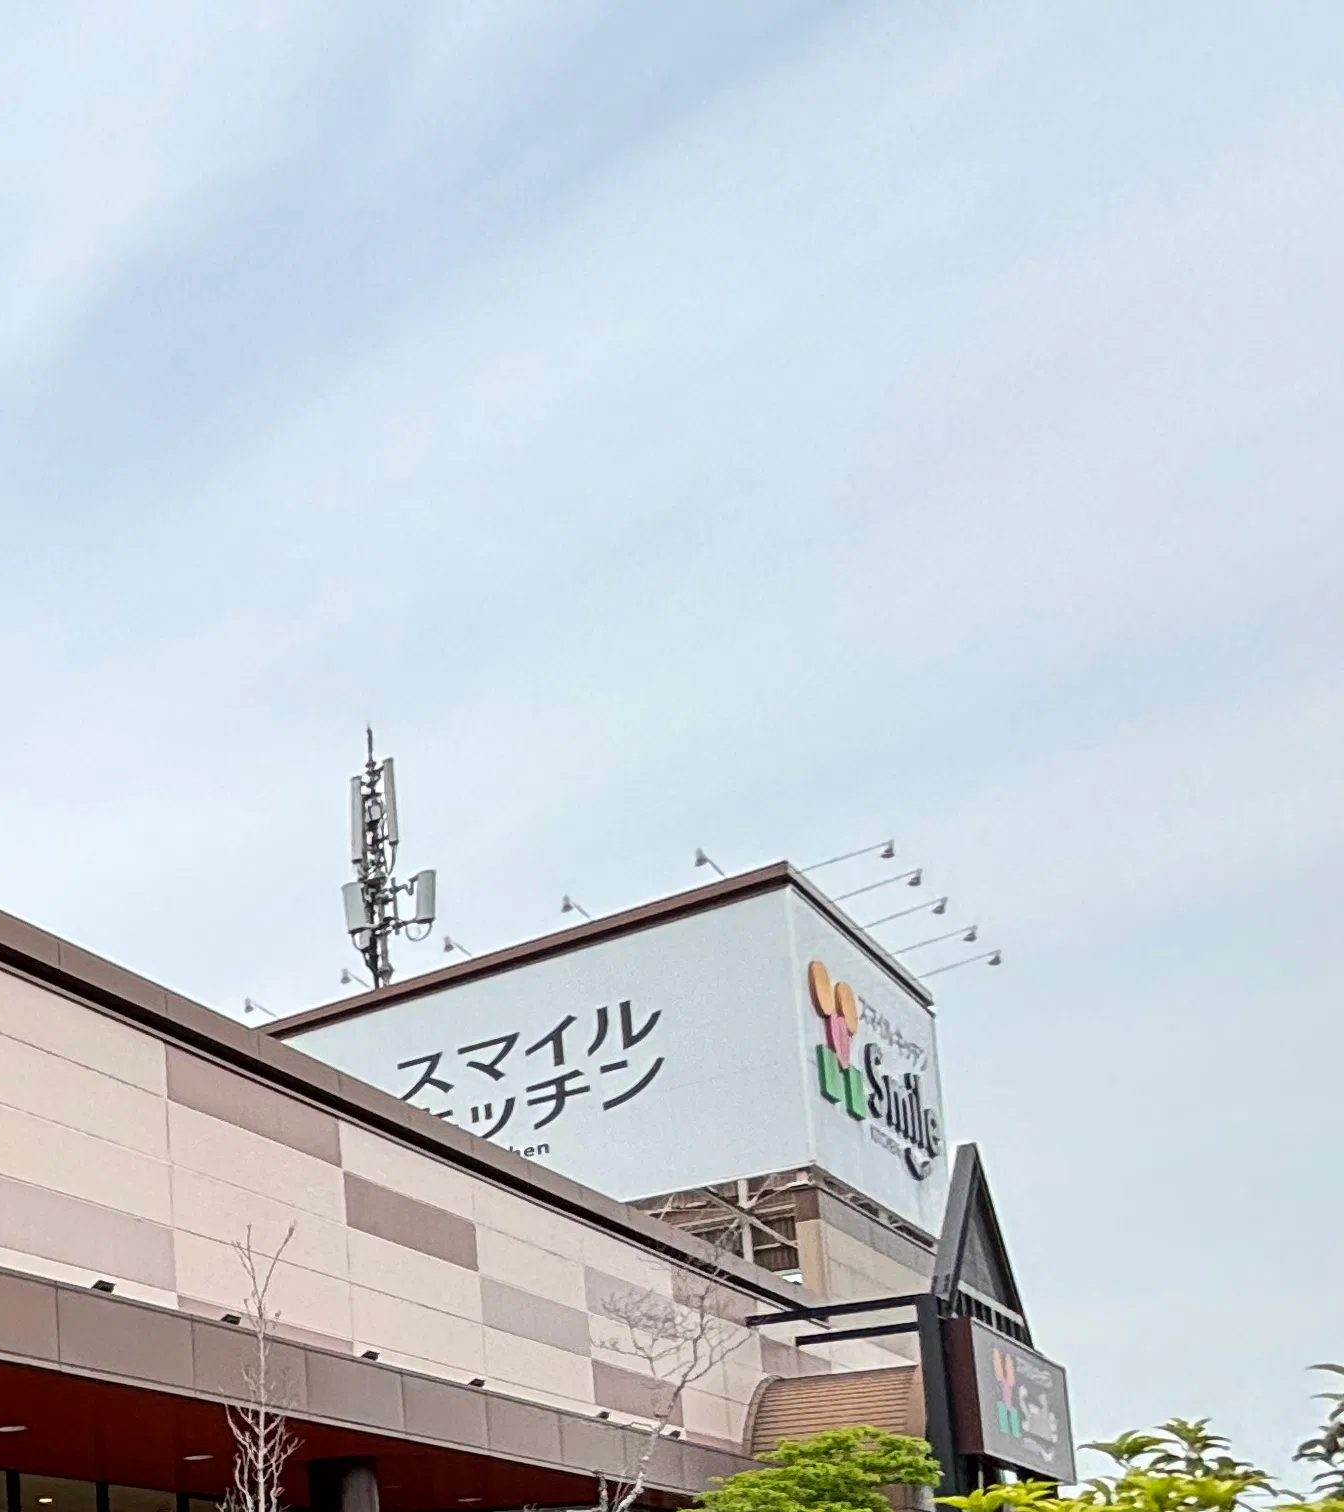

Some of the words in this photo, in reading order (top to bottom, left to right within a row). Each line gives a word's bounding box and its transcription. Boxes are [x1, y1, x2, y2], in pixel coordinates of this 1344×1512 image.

[397, 999, 662, 1101] スマイル
[422, 1056, 665, 1139] ッチン
[864, 1042, 940, 1159] Smile
